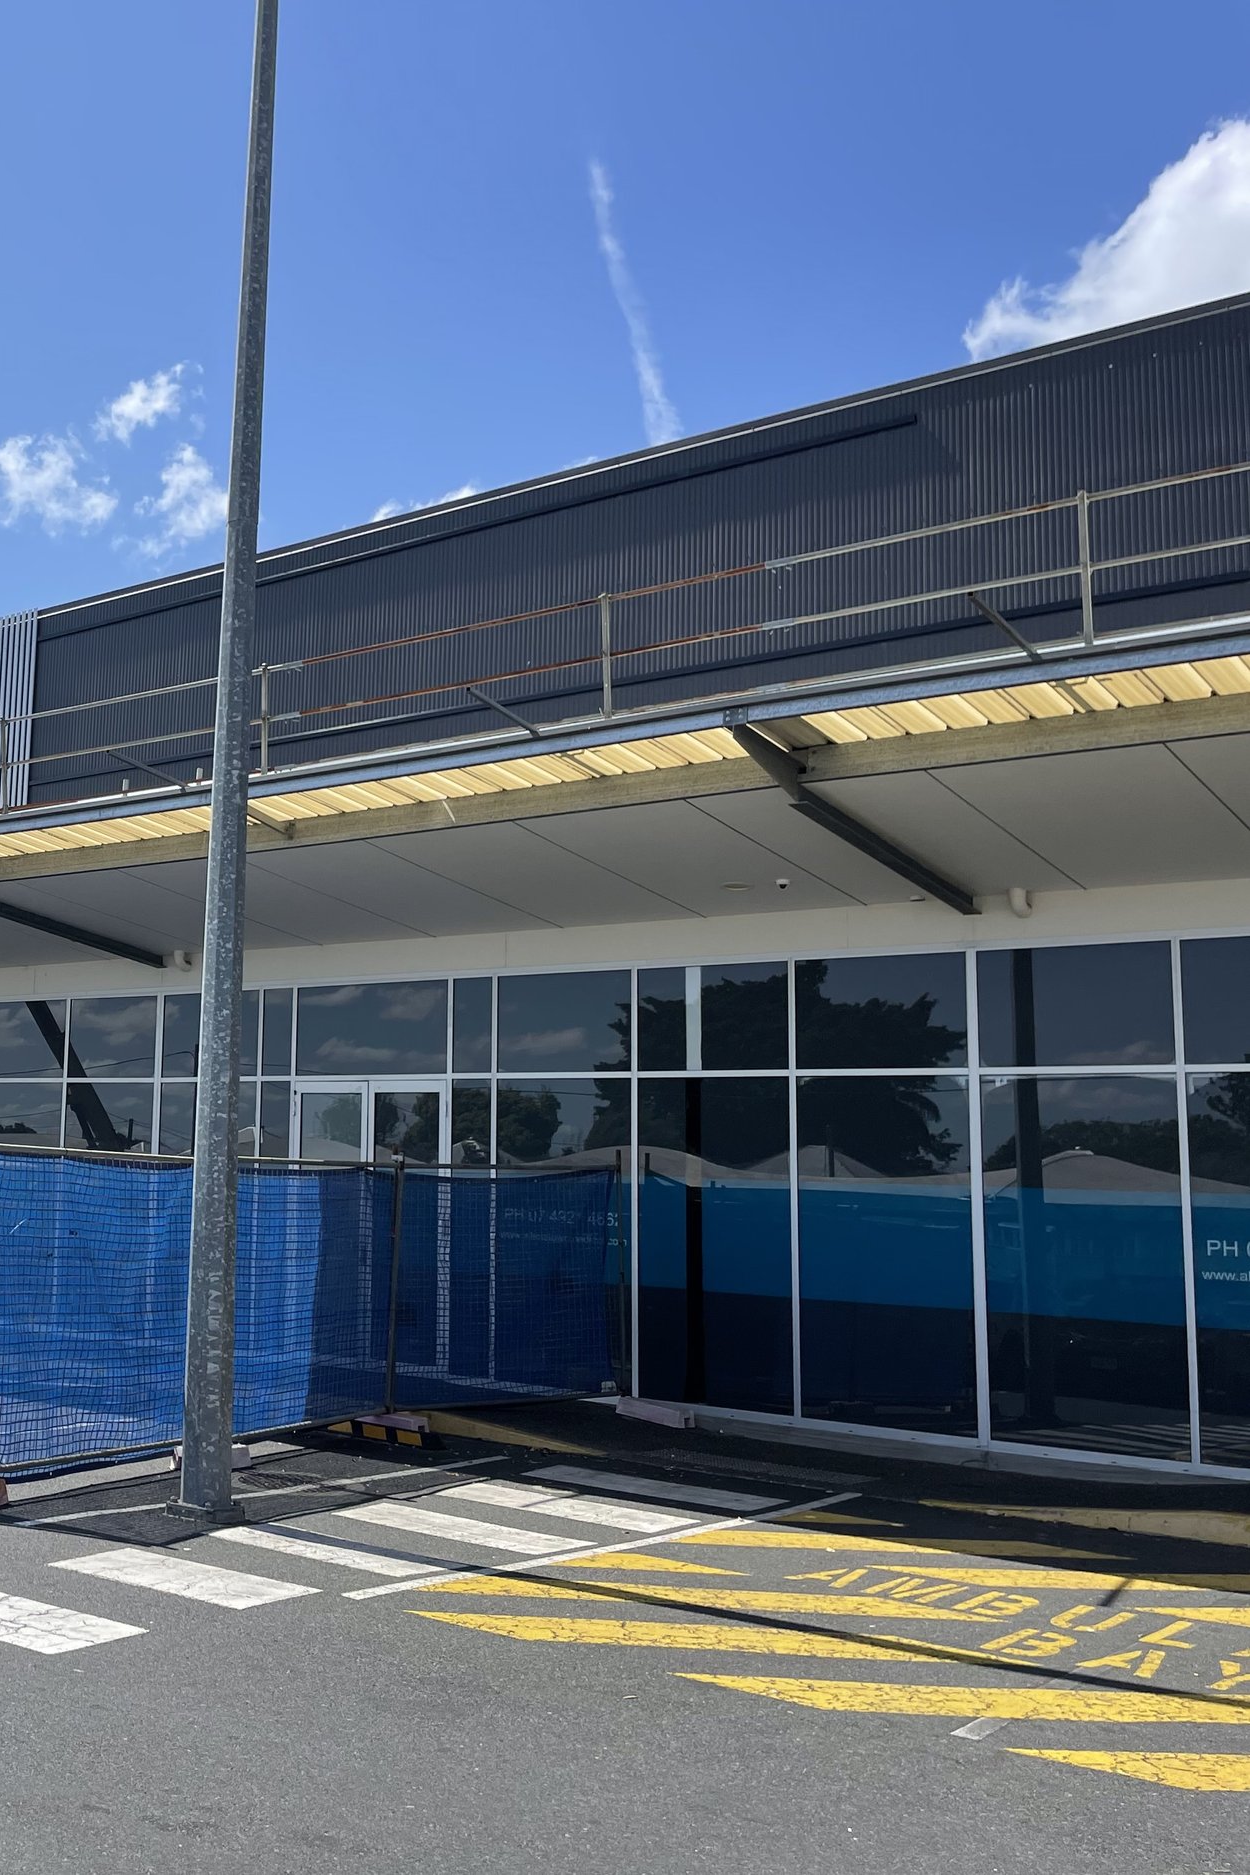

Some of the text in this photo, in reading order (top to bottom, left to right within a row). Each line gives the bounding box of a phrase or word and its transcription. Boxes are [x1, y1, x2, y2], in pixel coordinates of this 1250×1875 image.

[1206, 1239, 1239, 1257] PH
[1201, 1270, 1250, 1282] www.a
[783, 1567, 1250, 1657] AMBUL
